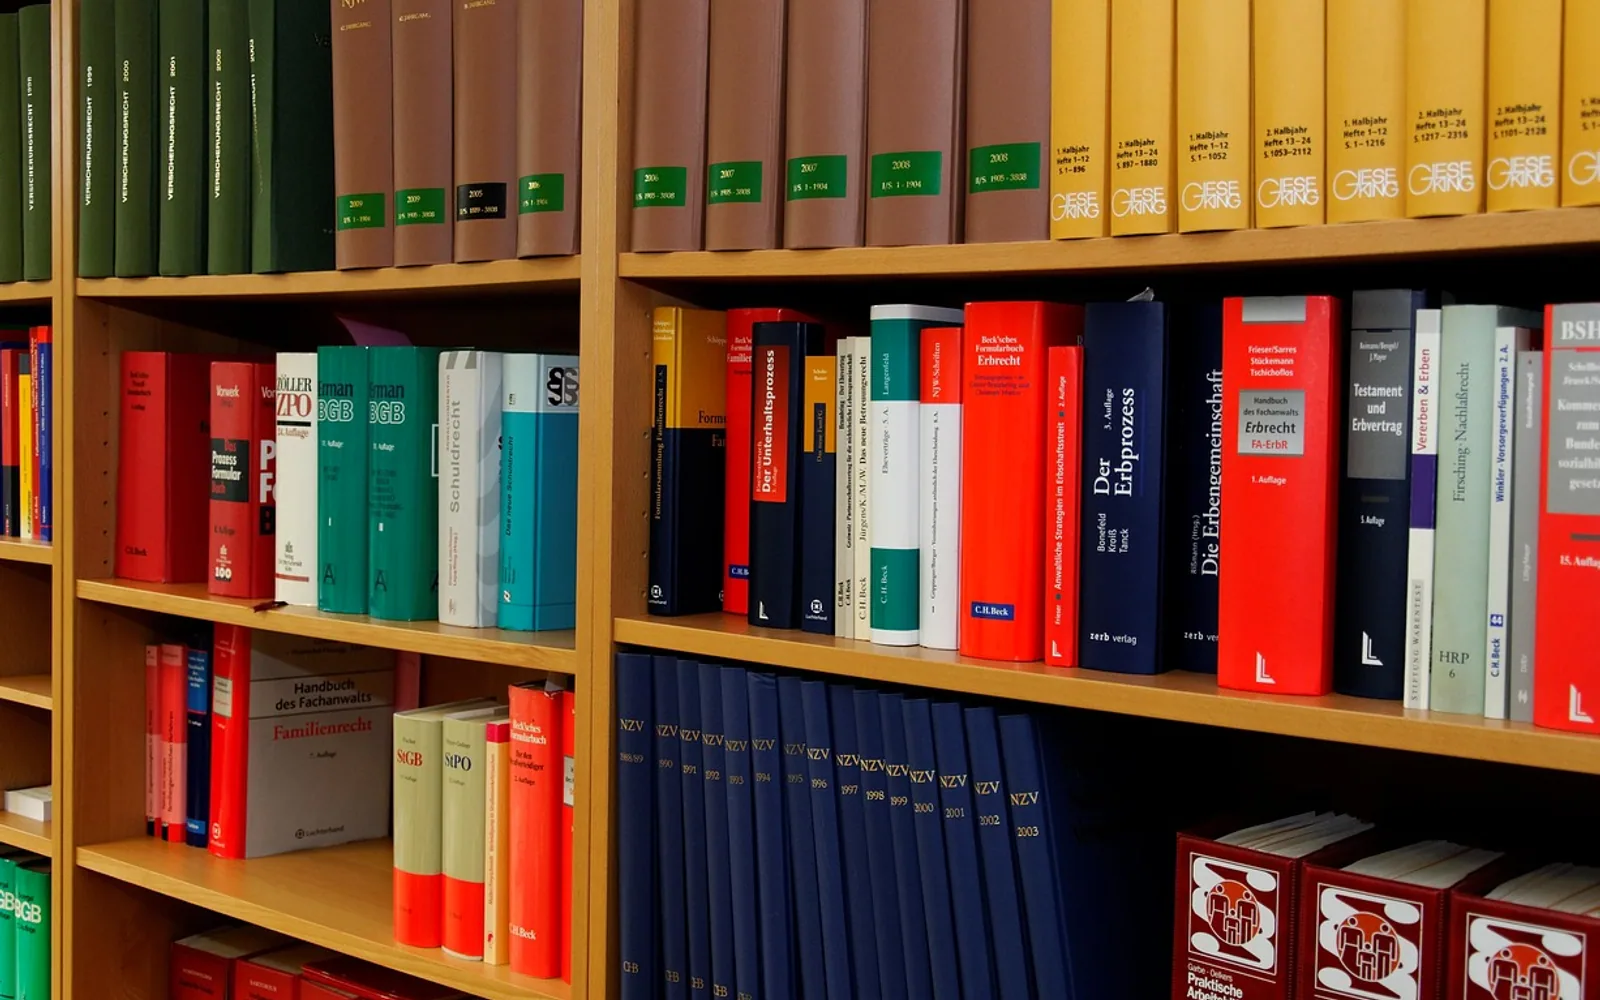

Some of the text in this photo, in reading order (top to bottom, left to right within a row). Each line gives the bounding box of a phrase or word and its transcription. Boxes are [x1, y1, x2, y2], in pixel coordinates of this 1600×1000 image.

[1426, 107, 1463, 119] Halbjahr
[1504, 103, 1542, 115] Halbjahr
[1352, 117, 1388, 128] Halbjahr
[1415, 122, 1436, 131] Hefte
[1494, 118, 1514, 128] Hefte
[1196, 131, 1230, 142] Halbjahr
[1274, 126, 1308, 137] Halbjahr
[1343, 130, 1365, 138] Hefte
[121, 90, 129, 203] VERSICHERUNGSRECHT
[167, 86, 175, 200] VERSICHERUNGSRECHT
[1125, 138, 1156, 149] Halbjahr
[1189, 144, 1208, 152] Hefte
[1264, 140, 1283, 148] Hefte
[85, 96, 93, 206] VERSICHERUNGSRECHT
[1062, 145, 1090, 155] Halbjahr
[1116, 151, 1133, 160] Hefte
[989, 153, 1009, 163] 2008
[1056, 157, 1072, 165] Hefte
[801, 163, 818, 173] 2007
[891, 160, 911, 170] 2008
[720, 169, 735, 179] 2007
[1248, 345, 1297, 354] Frieser/Sarres
[978, 355, 1021, 366] Erbrecht
[1250, 356, 1294, 365] Stückemann
[882, 353, 891, 395] Langenfeld
[932, 342, 942, 398] NJW-Schriften
[1250, 367, 1294, 377] Tschichoflos
[858, 356, 869, 425] Betreuungsrecht
[1058, 376, 1067, 400] Auflage
[1353, 382, 1403, 398] Testament
[276, 393, 312, 418] ZPO
[1104, 388, 1114, 420] Auflage
[1253, 396, 1288, 405] Handbuch
[1416, 347, 1431, 451] Vererben & Erben
[1243, 408, 1299, 417] des Fachanwalts
[1366, 402, 1387, 415] und
[761, 349, 776, 493] Der Unterhaltsprozess
[1245, 421, 1296, 434] Erbrecht
[1352, 417, 1402, 436] Erbvertrag
[1453, 362, 1471, 502] Firsching Nachlaßrecht
[1496, 367, 1509, 503] Winkler Vorsorgeverfügungen
[1114, 388, 1139, 497] Erbprozess
[1251, 439, 1289, 449] FA-ErbR
[212, 450, 237, 466] Prozess
[449, 400, 461, 514] Schuldrecht
[654, 387, 665, 520] Formularsammlung Familienrecht
[859, 448, 867, 464] Das
[882, 429, 891, 474] Eheverträge
[1056, 422, 1066, 485] Erbschaftsstreit
[211, 464, 241, 482] Formular
[1094, 457, 1110, 495] Der
[1202, 368, 1223, 577] Die Erbengemeinschaft
[1259, 475, 1287, 486] Auflage
[1056, 485, 1063, 497] im
[1055, 497, 1065, 541] Strategien
[1366, 515, 1385, 528] Auflage
[1097, 513, 1107, 552] Bonefeld
[1108, 528, 1117, 553] Kroiß
[1119, 528, 1129, 553] Tanck
[1054, 541, 1063, 590] Anwaltliche
[215, 566, 232, 579] 100
[975, 605, 1009, 616] C.H.Beck
[1090, 632, 1137, 645] zerb verlag
[1184, 631, 1204, 641] zerb
[1410, 584, 1422, 700] STIFTUNG WARENTEST
[1438, 650, 1470, 665] HRP
[1491, 638, 1500, 678] C.H.Beck
[1448, 669, 1456, 679] 6
[294, 679, 355, 695] Handbuch
[275, 692, 372, 711] des Fachanwalts
[273, 717, 372, 742] Familienrecht
[620, 718, 644, 731] NZV
[656, 724, 678, 737] NZV
[679, 729, 700, 741] NZV
[702, 733, 724, 746] NZV
[725, 740, 748, 752] NZV
[752, 739, 775, 750] NZV
[784, 743, 806, 755] NZV
[396, 748, 423, 767] StGB
[807, 748, 830, 760] NZV
[836, 754, 860, 766] NZV
[444, 752, 472, 772] StPO
[860, 759, 886, 772] NZV
[683, 764, 697, 774] 1991
[705, 770, 720, 781] 1992
[886, 764, 909, 776] NZV
[756, 772, 771, 782] 1994
[909, 770, 935, 784] NZV
[940, 774, 967, 788] NZV
[812, 779, 827, 789] 1996
[841, 785, 858, 795] 1997
[974, 780, 1000, 795] NZV
[866, 790, 885, 800] 1998
[891, 796, 908, 806] 1999
[1010, 791, 1039, 806] NZV
[914, 802, 934, 812] 2000
[945, 807, 965, 819] 2001
[980, 814, 1000, 825] 2002
[306, 825, 344, 837] Luchterhand
[1017, 826, 1039, 837] 2003
[14, 898, 41, 923] BGB
[1187, 970, 1244, 999] Praktische
